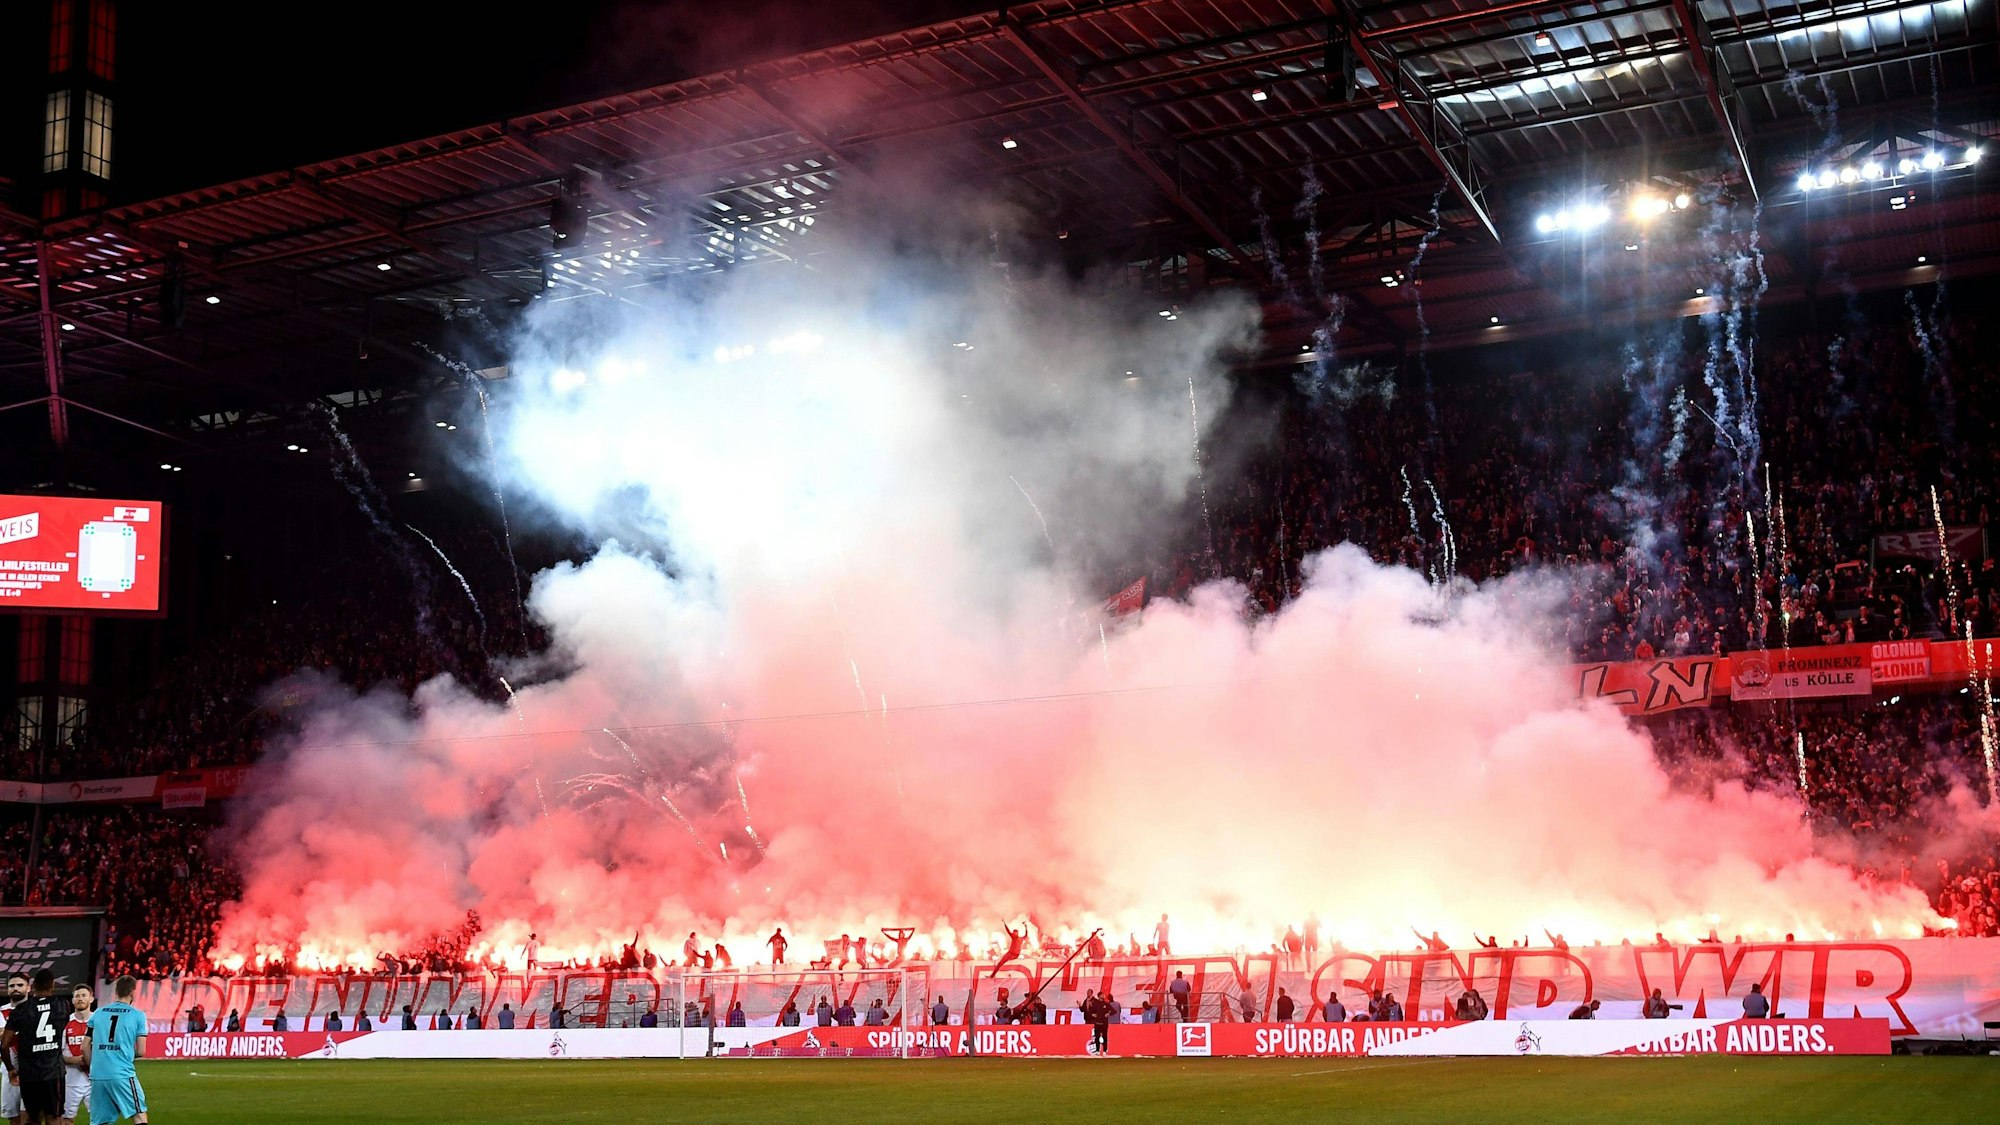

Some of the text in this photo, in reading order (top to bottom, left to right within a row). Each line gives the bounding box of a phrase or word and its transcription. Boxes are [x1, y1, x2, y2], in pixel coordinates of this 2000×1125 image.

[1778, 656, 1862, 672] PROMINENZ
[1807, 671, 1855, 686] KÖLLE
[1305, 950, 1593, 1022] SIND
[1633, 943, 1920, 1036] WIR
[36, 1011, 56, 1043] 4
[108, 1014, 119, 1043] 1
[957, 1030, 1037, 1053] ANDERS.
[1255, 1024, 1355, 1053] SPÜRBAR
[1726, 1024, 1834, 1053] ANDERS.
[165, 1033, 287, 1057] SPÜRBAR ANDERS.
